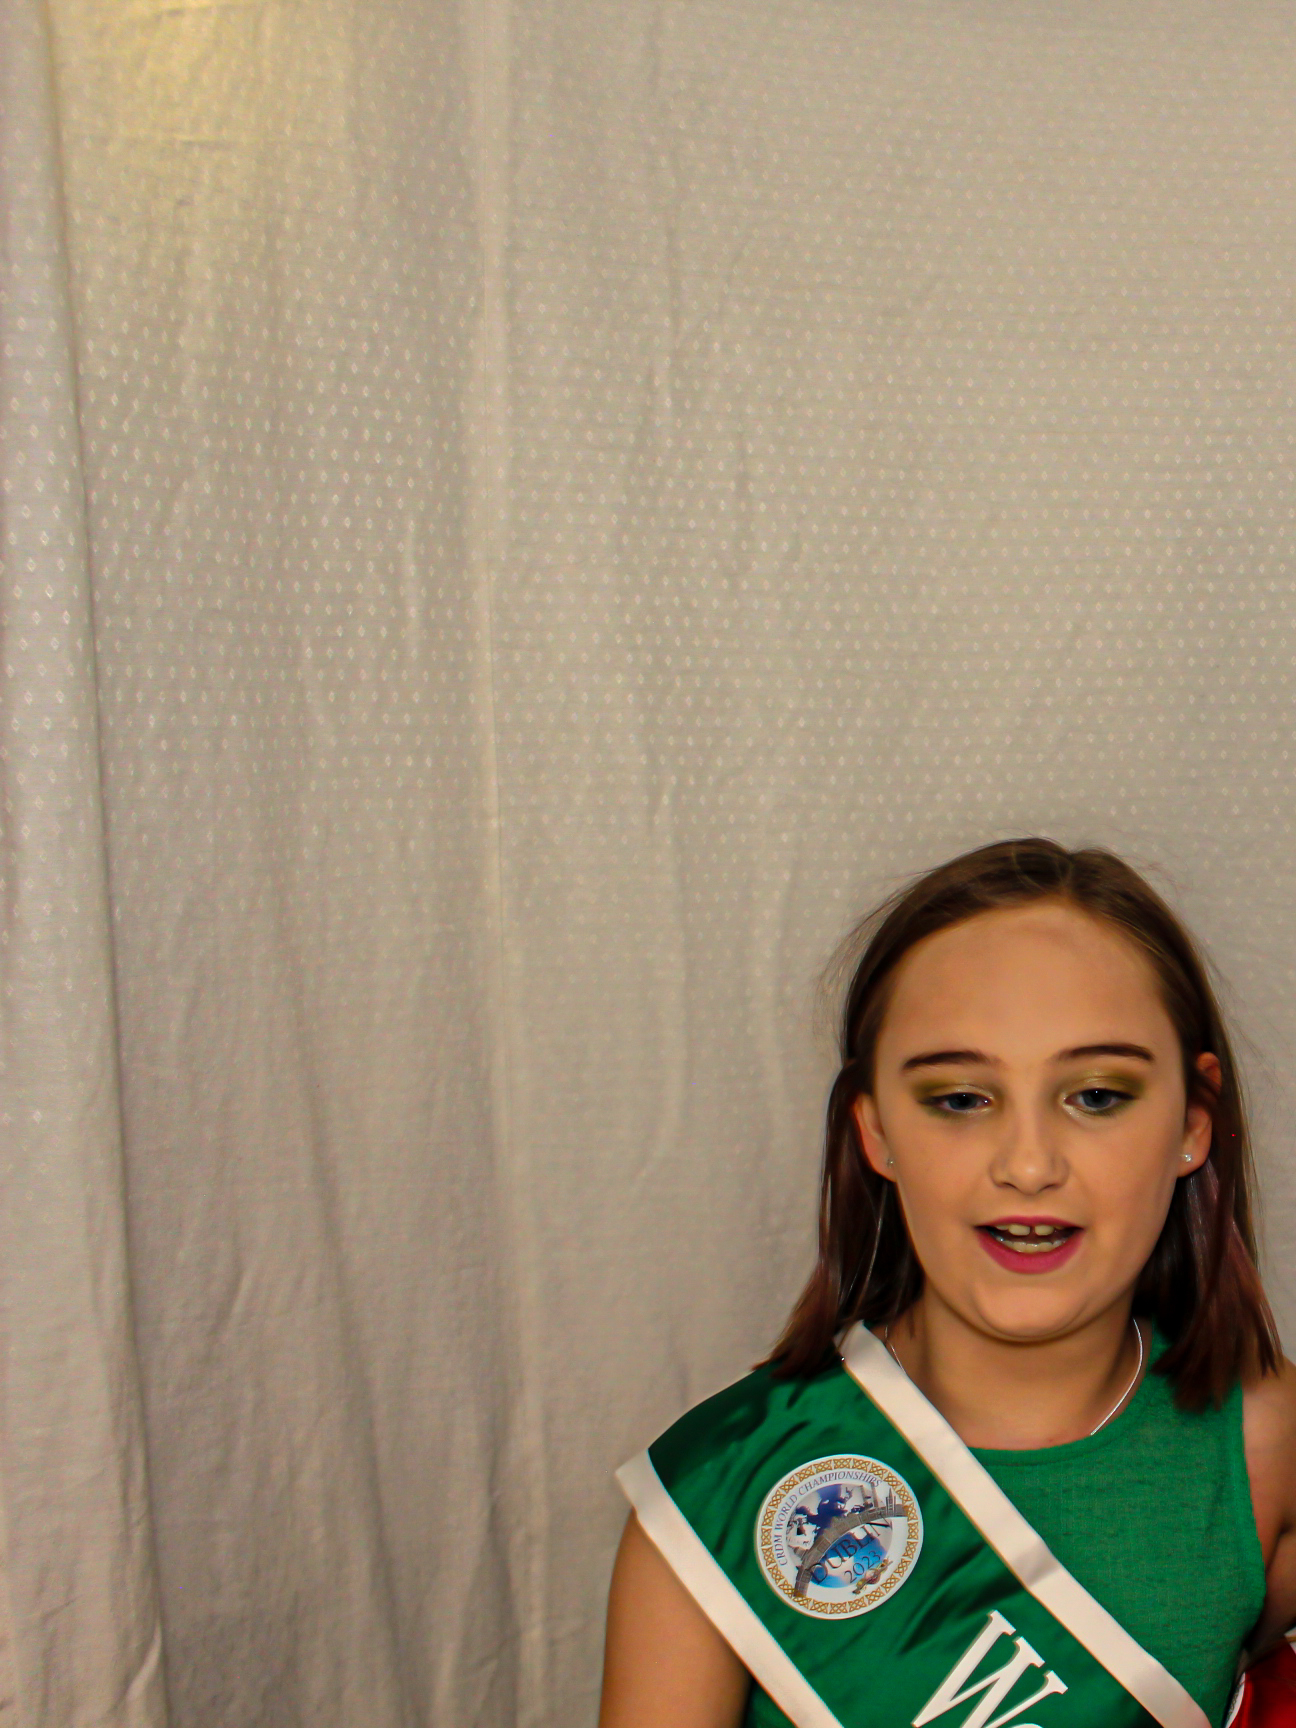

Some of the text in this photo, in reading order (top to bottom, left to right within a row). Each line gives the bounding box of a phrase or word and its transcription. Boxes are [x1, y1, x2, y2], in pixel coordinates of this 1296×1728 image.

[774, 1471, 883, 1566] CRDM WORLD CHAMPIONSHIPS
[810, 1513, 891, 1584] DUBLIN
[844, 1550, 882, 1583] 2023
[911, 1609, 1069, 1728] W
